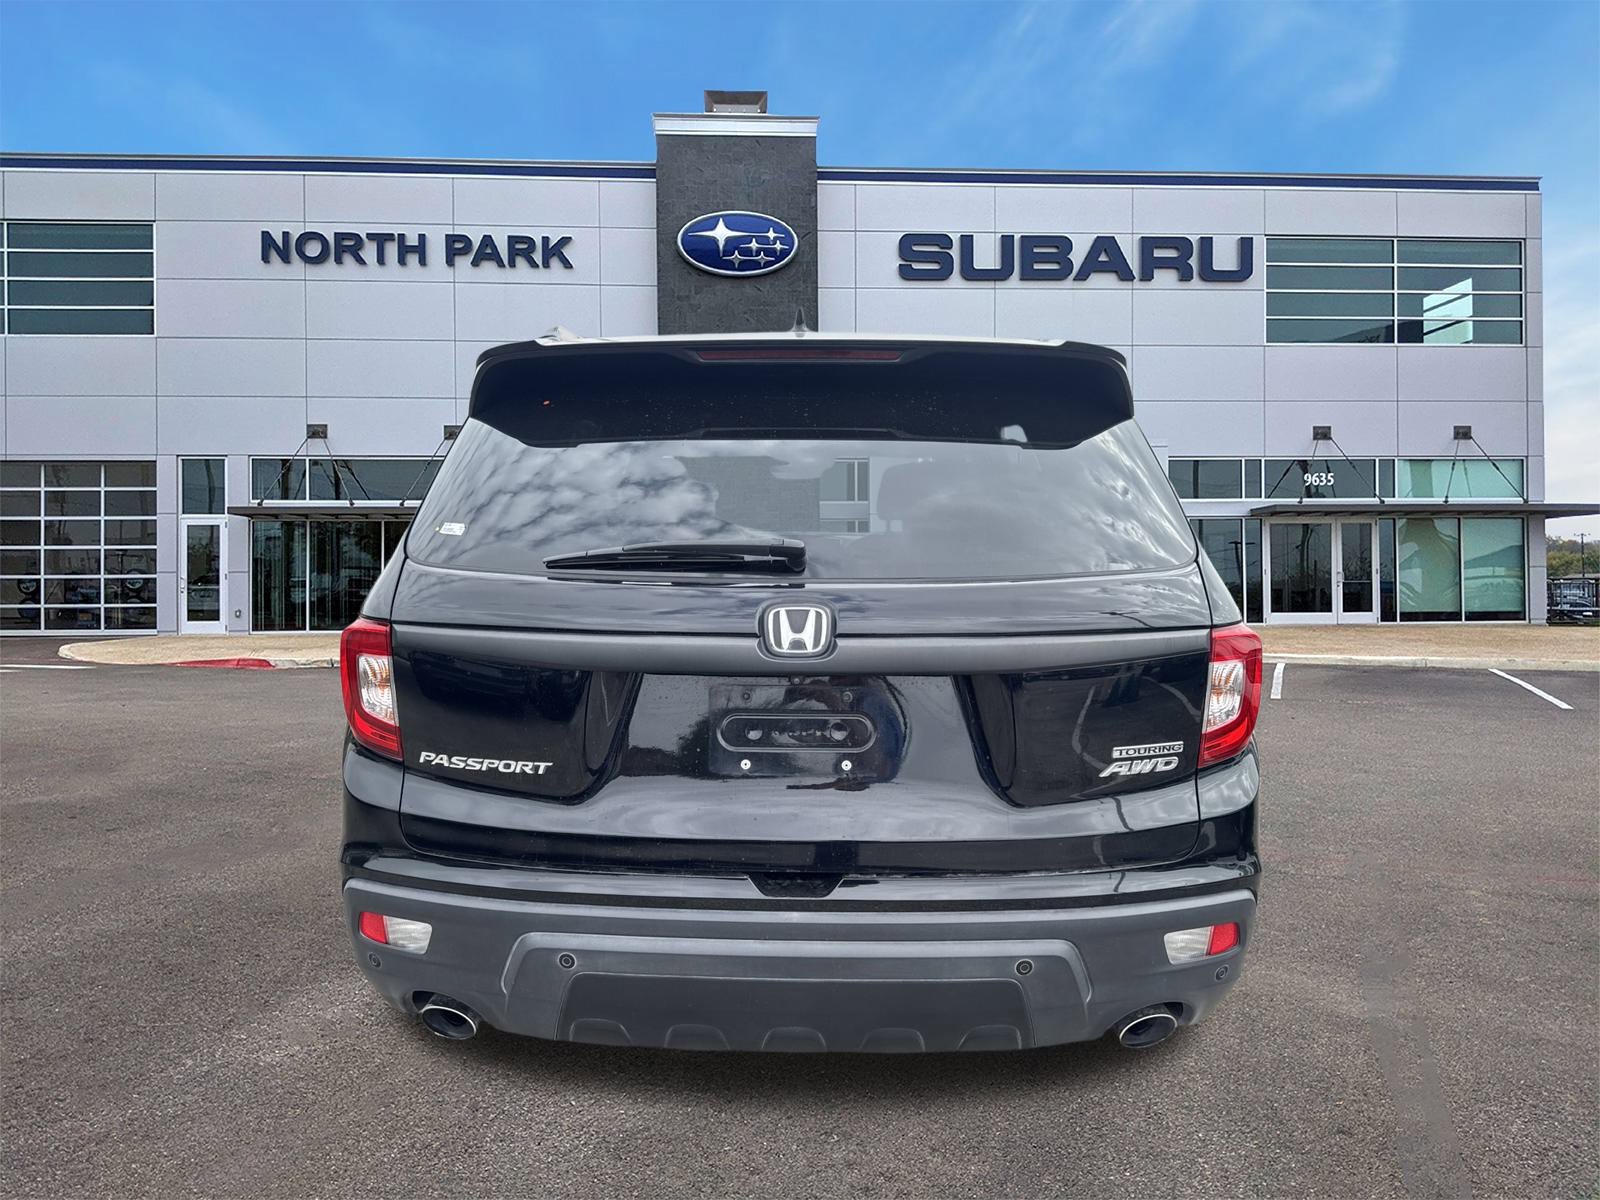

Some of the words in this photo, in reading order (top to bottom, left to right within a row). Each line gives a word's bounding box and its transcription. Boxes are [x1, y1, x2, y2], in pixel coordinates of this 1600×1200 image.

[260, 230, 428, 266] NORTH
[445, 233, 574, 269] PARK
[898, 233, 1254, 282] SUBARU
[1303, 472, 1335, 486] 9635
[1115, 743, 1184, 757] TOURING
[419, 751, 553, 775] PASSPORT
[1099, 756, 1179, 778] AWD
